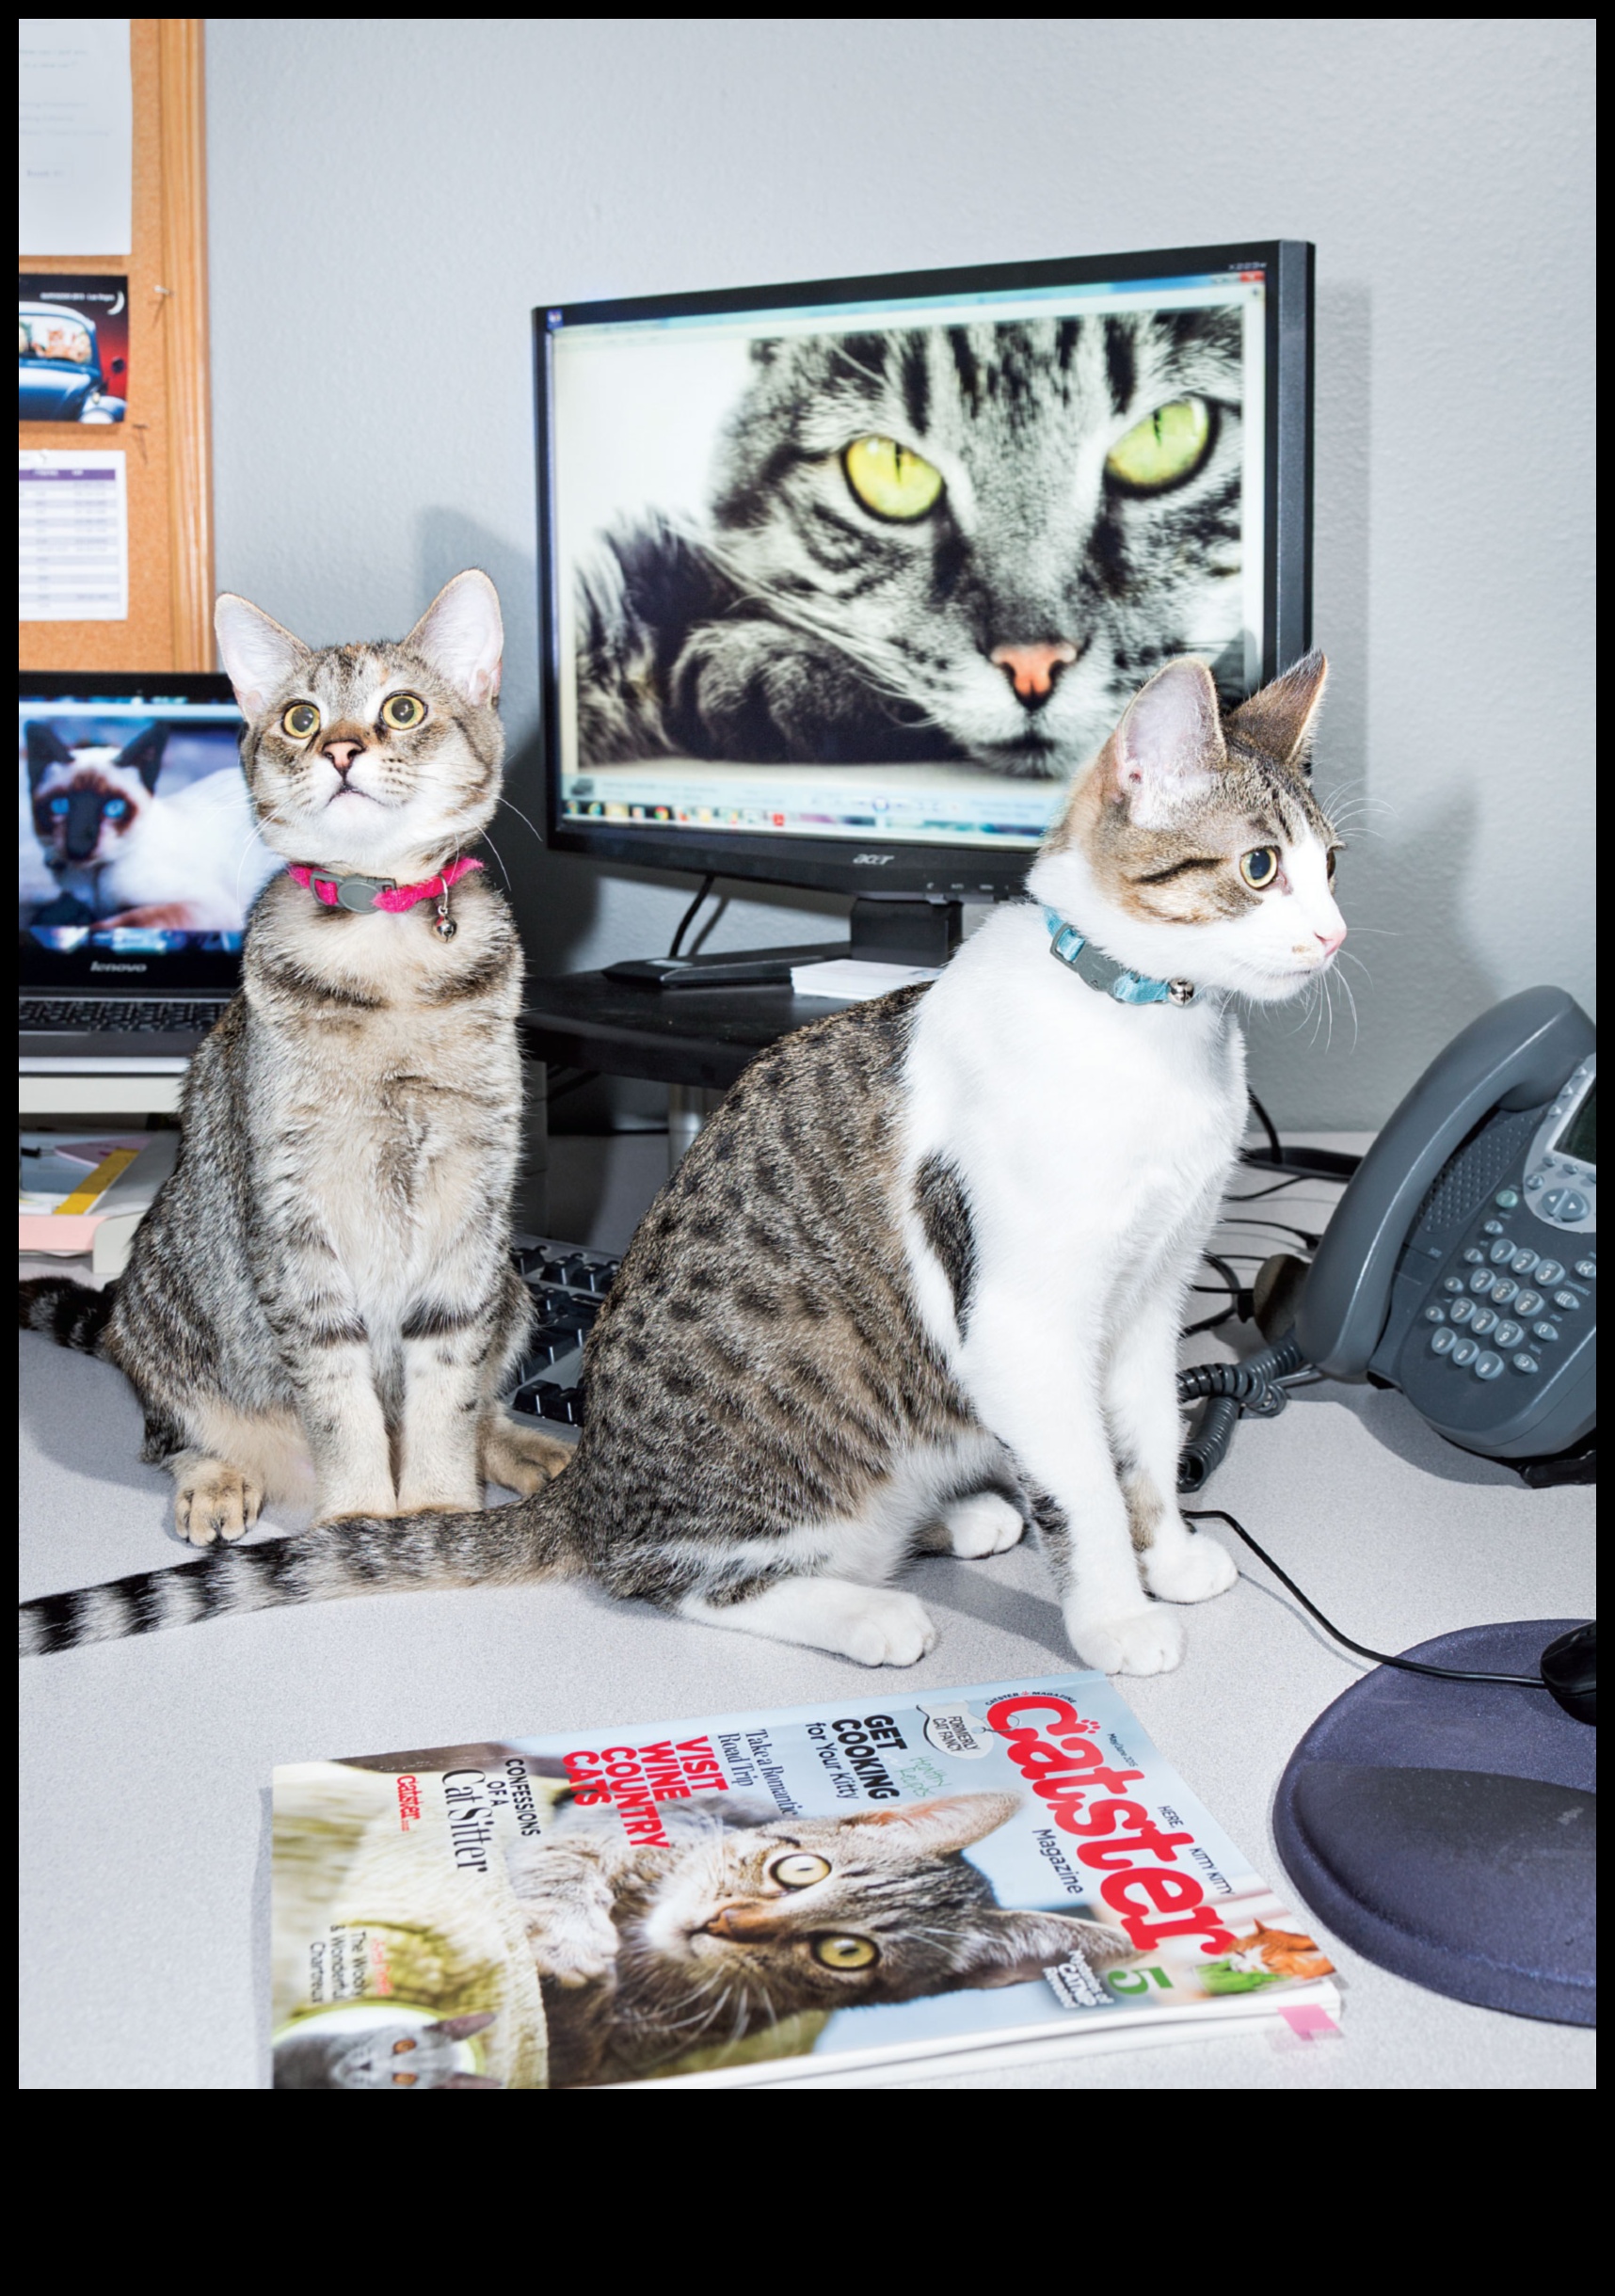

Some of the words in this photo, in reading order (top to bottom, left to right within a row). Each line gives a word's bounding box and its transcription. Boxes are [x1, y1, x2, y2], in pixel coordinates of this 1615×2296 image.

[853, 853, 895, 866] acer
[89, 960, 148, 973] lenovo
[1515, 1259, 1527, 1269] 2
[1540, 1269, 1552, 1281] 3
[1499, 1331, 1511, 1342] 9
[806, 1722, 827, 1741] for
[864, 1714, 908, 1750] GET
[933, 1717, 950, 1731] CAT
[948, 1715, 981, 1751] FORMERLY
[718, 1732, 751, 1763] Road
[745, 1729, 773, 1758] Take
[939, 1729, 966, 1752] FANCY
[638, 1740, 692, 1802] WINE
[675, 1735, 729, 1792] VISIT
[756, 1758, 773, 1766] a
[815, 1743, 843, 1770] Your
[831, 1718, 901, 1800] COOKING
[487, 1780, 508, 1796] OF
[562, 1750, 613, 1806] CATS
[731, 1762, 759, 1787] Trip
[829, 1772, 859, 1800] Kitty
[504, 1759, 541, 1837] CONFESSIONS
[600, 1746, 671, 1848] COUNTRY
[760, 1765, 804, 1816] Romantic
[1031, 1828, 1084, 1894] Magazine
[1189, 1847, 1217, 1871] KITTY
[1206, 1871, 1236, 1896] KITTY
[1108, 1966, 1174, 1996] 5
